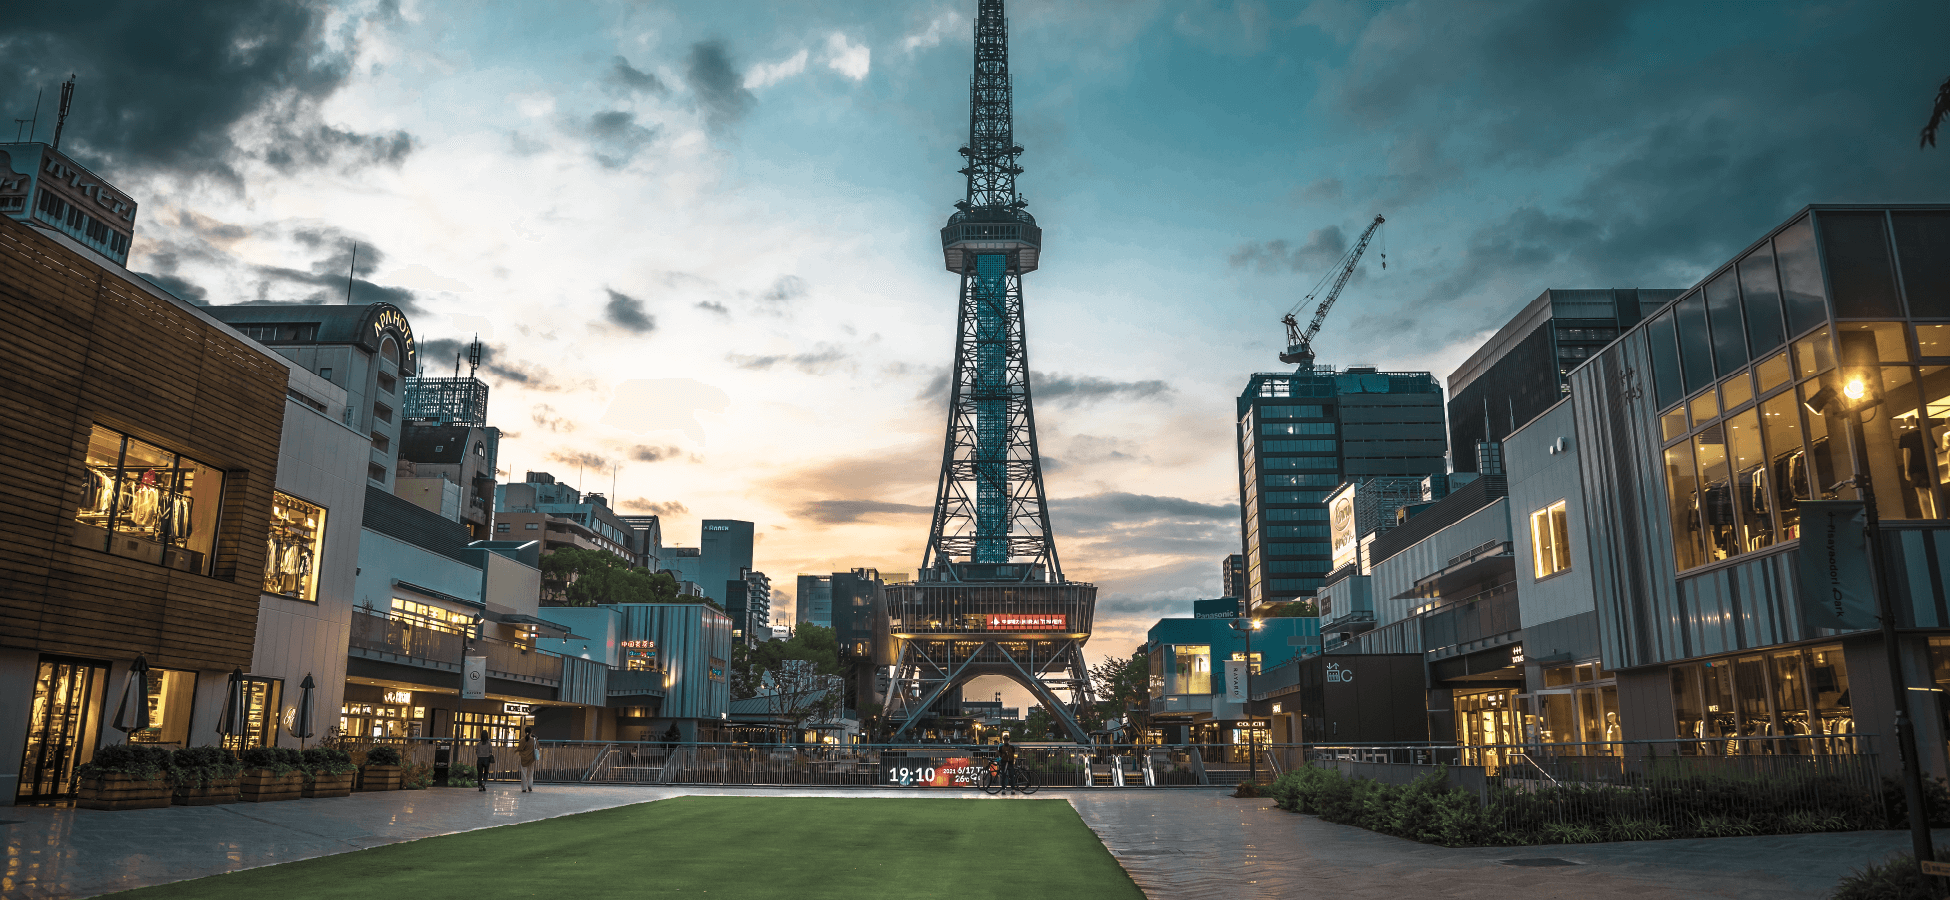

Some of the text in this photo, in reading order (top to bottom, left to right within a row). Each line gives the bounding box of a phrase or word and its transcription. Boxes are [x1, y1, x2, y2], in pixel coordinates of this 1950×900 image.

[374, 310, 415, 361] APA HOTEL
[1832, 587, 1844, 617] Park
[1196, 610, 1234, 619] Panasonic
[889, 767, 935, 782] 19:10
[957, 767, 975, 775] 6/17
